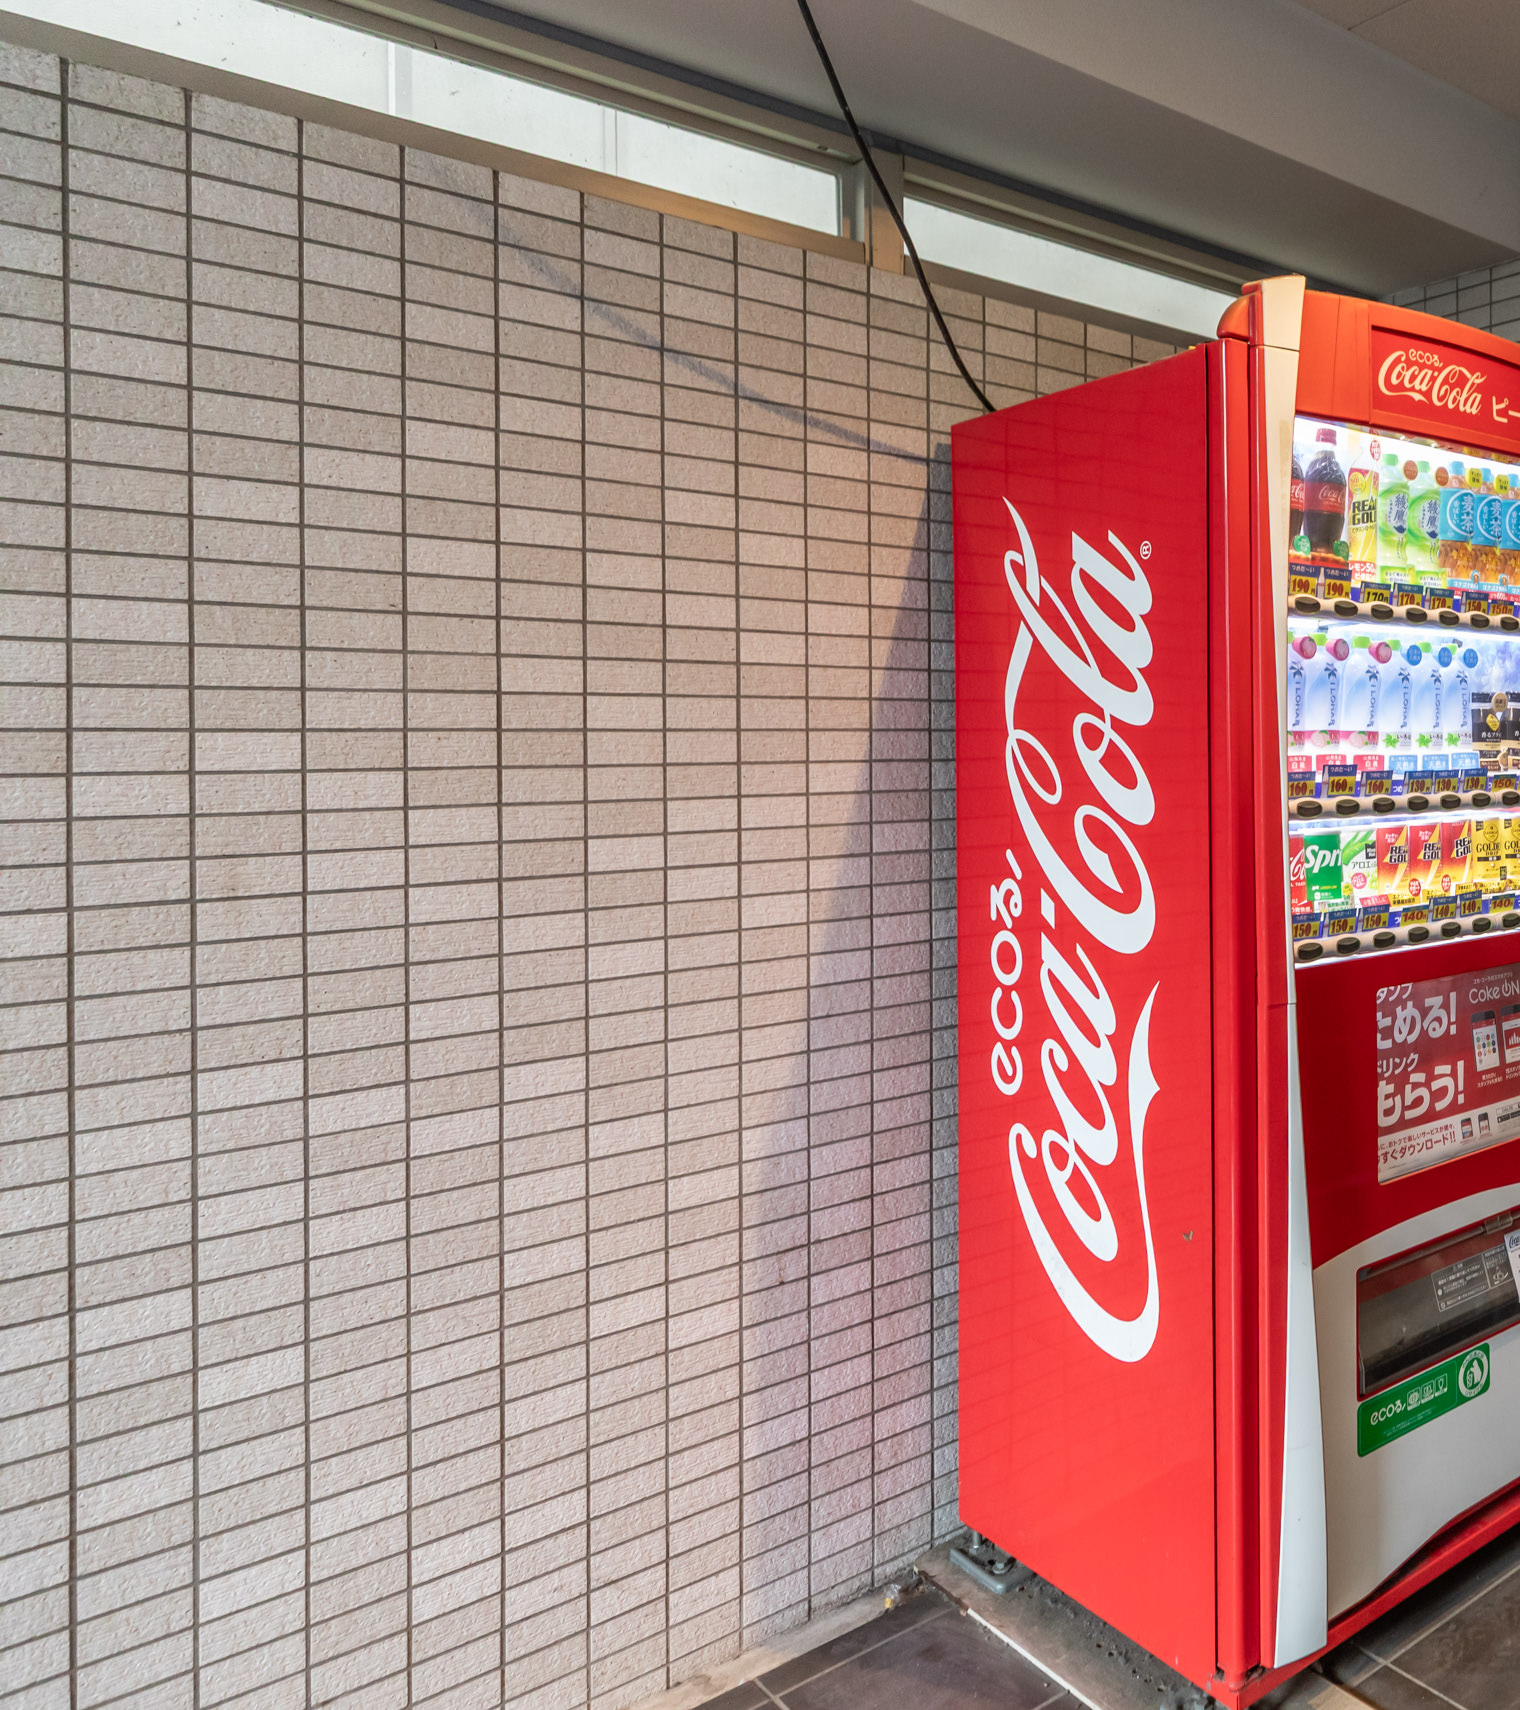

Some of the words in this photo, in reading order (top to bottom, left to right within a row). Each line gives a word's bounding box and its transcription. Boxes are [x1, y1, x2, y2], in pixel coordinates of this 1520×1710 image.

[1461, 494, 1474, 532] 麦茶
[1290, 782, 1314, 795] 160円
[1330, 778, 1353, 793] 160円
[1368, 781, 1390, 794] 160円
[1330, 919, 1354, 932] 150円
[1365, 914, 1387, 927] 150円
[1469, 985, 1500, 1004] Coke
[1377, 1060, 1464, 1128] もらう!
